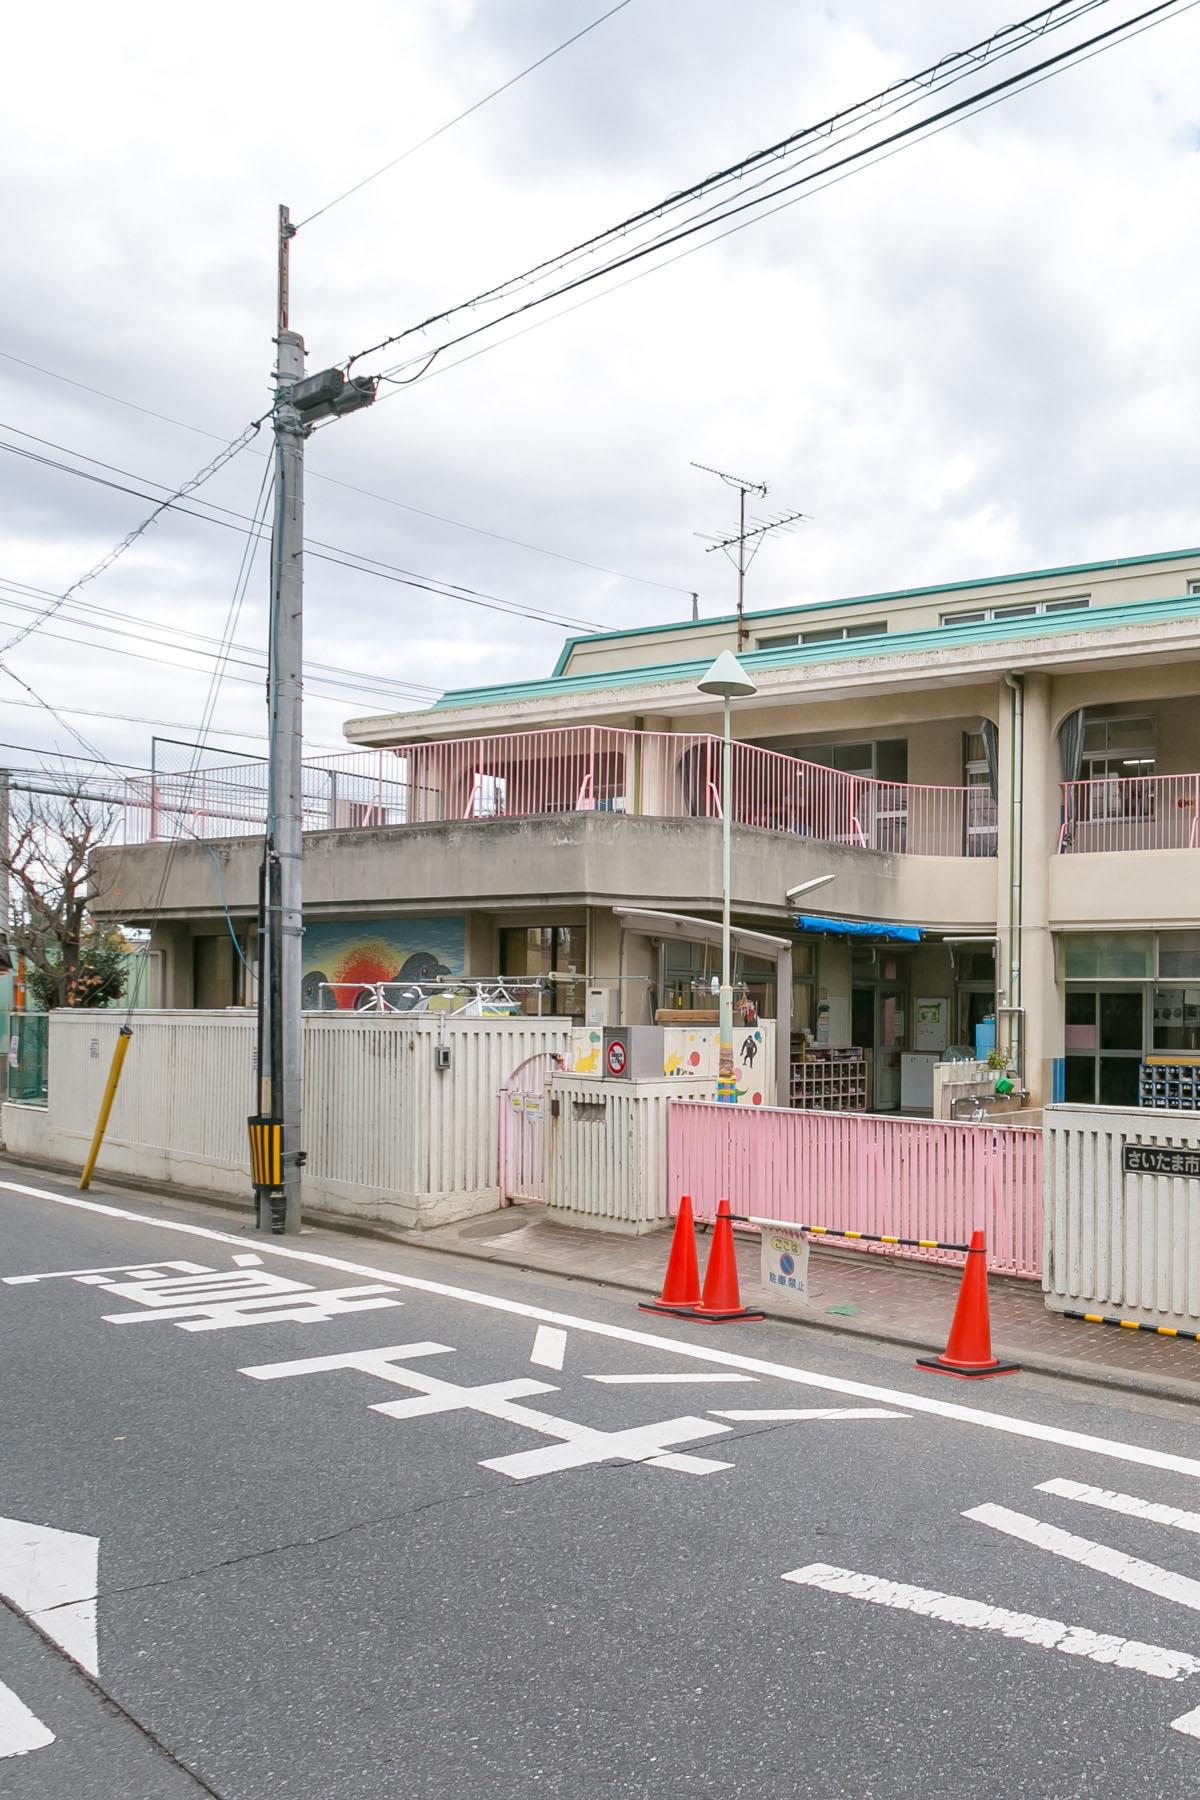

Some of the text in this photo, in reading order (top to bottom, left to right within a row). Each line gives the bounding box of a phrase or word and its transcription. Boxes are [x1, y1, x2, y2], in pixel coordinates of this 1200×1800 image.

[774, 1238, 799, 1254] ここは
[768, 1271, 805, 1293] 駐車禁止
